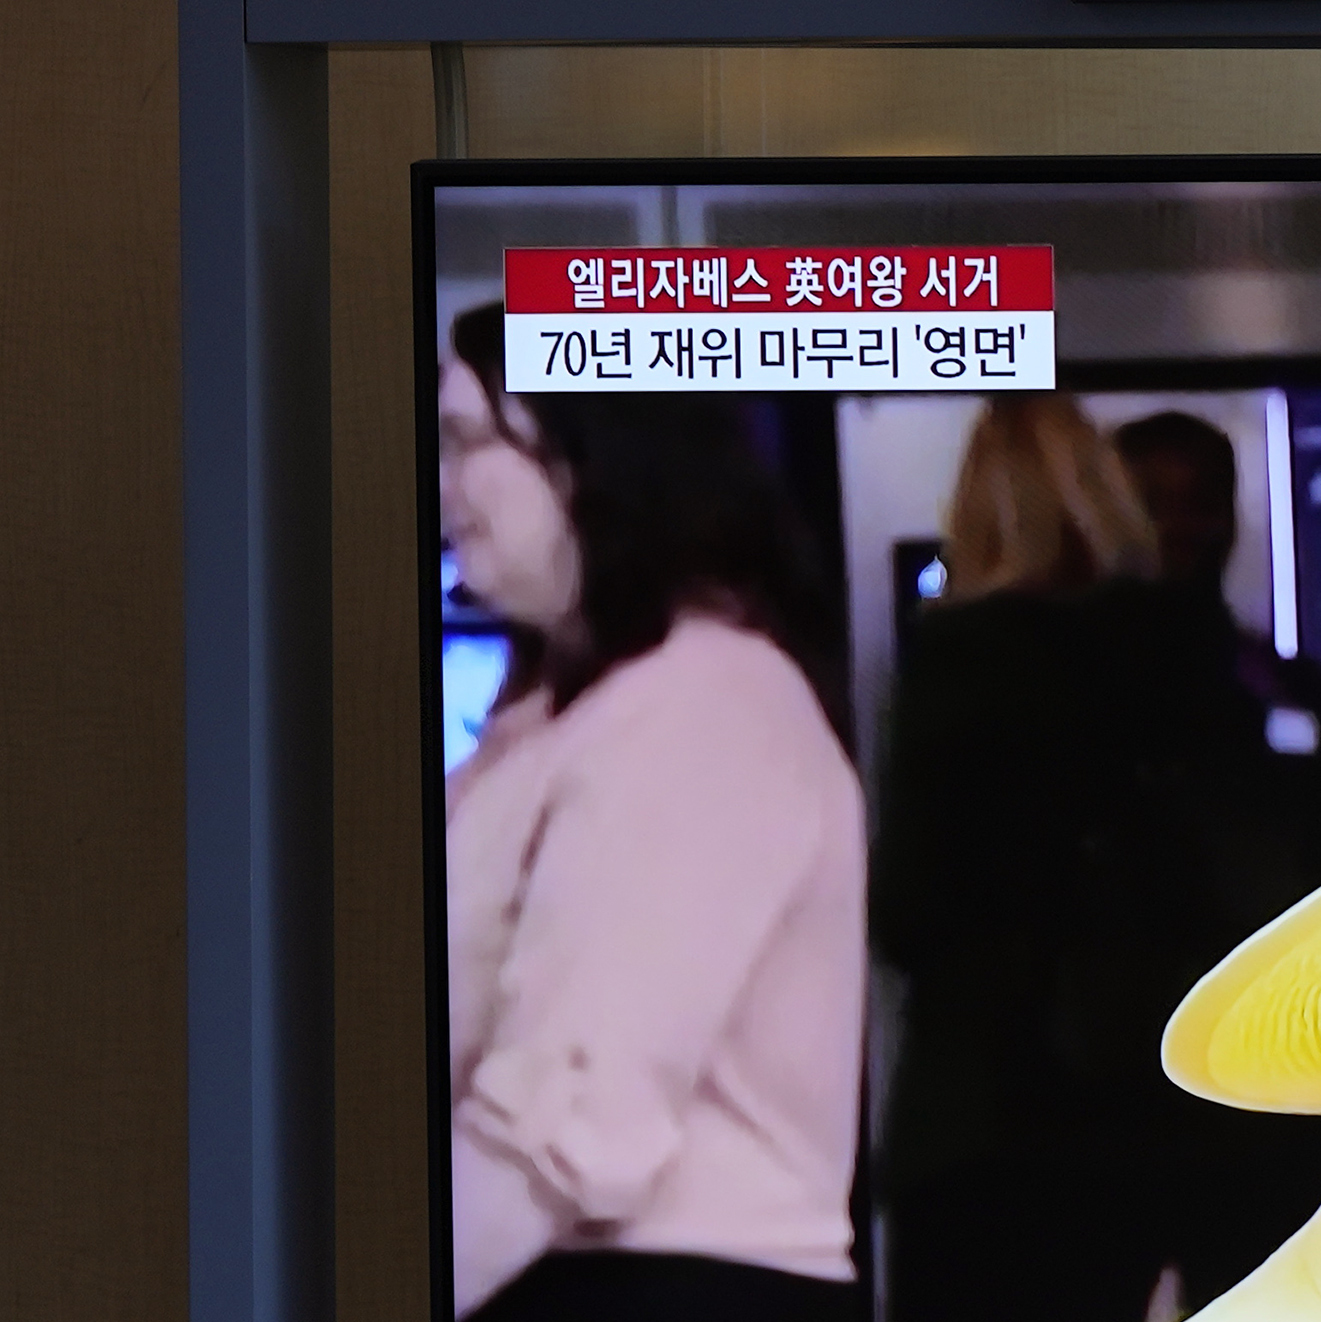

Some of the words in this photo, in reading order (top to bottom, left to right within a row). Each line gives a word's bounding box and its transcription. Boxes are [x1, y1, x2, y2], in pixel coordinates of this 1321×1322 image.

[567, 256, 771, 309] 엘리자베스
[785, 255, 907, 308] 英여왕
[919, 255, 998, 307] 서거
[540, 328, 633, 379] 70년
[648, 327, 742, 379] 재위
[759, 327, 899, 379] 마무리
[915, 324, 1026, 379] '영면'
